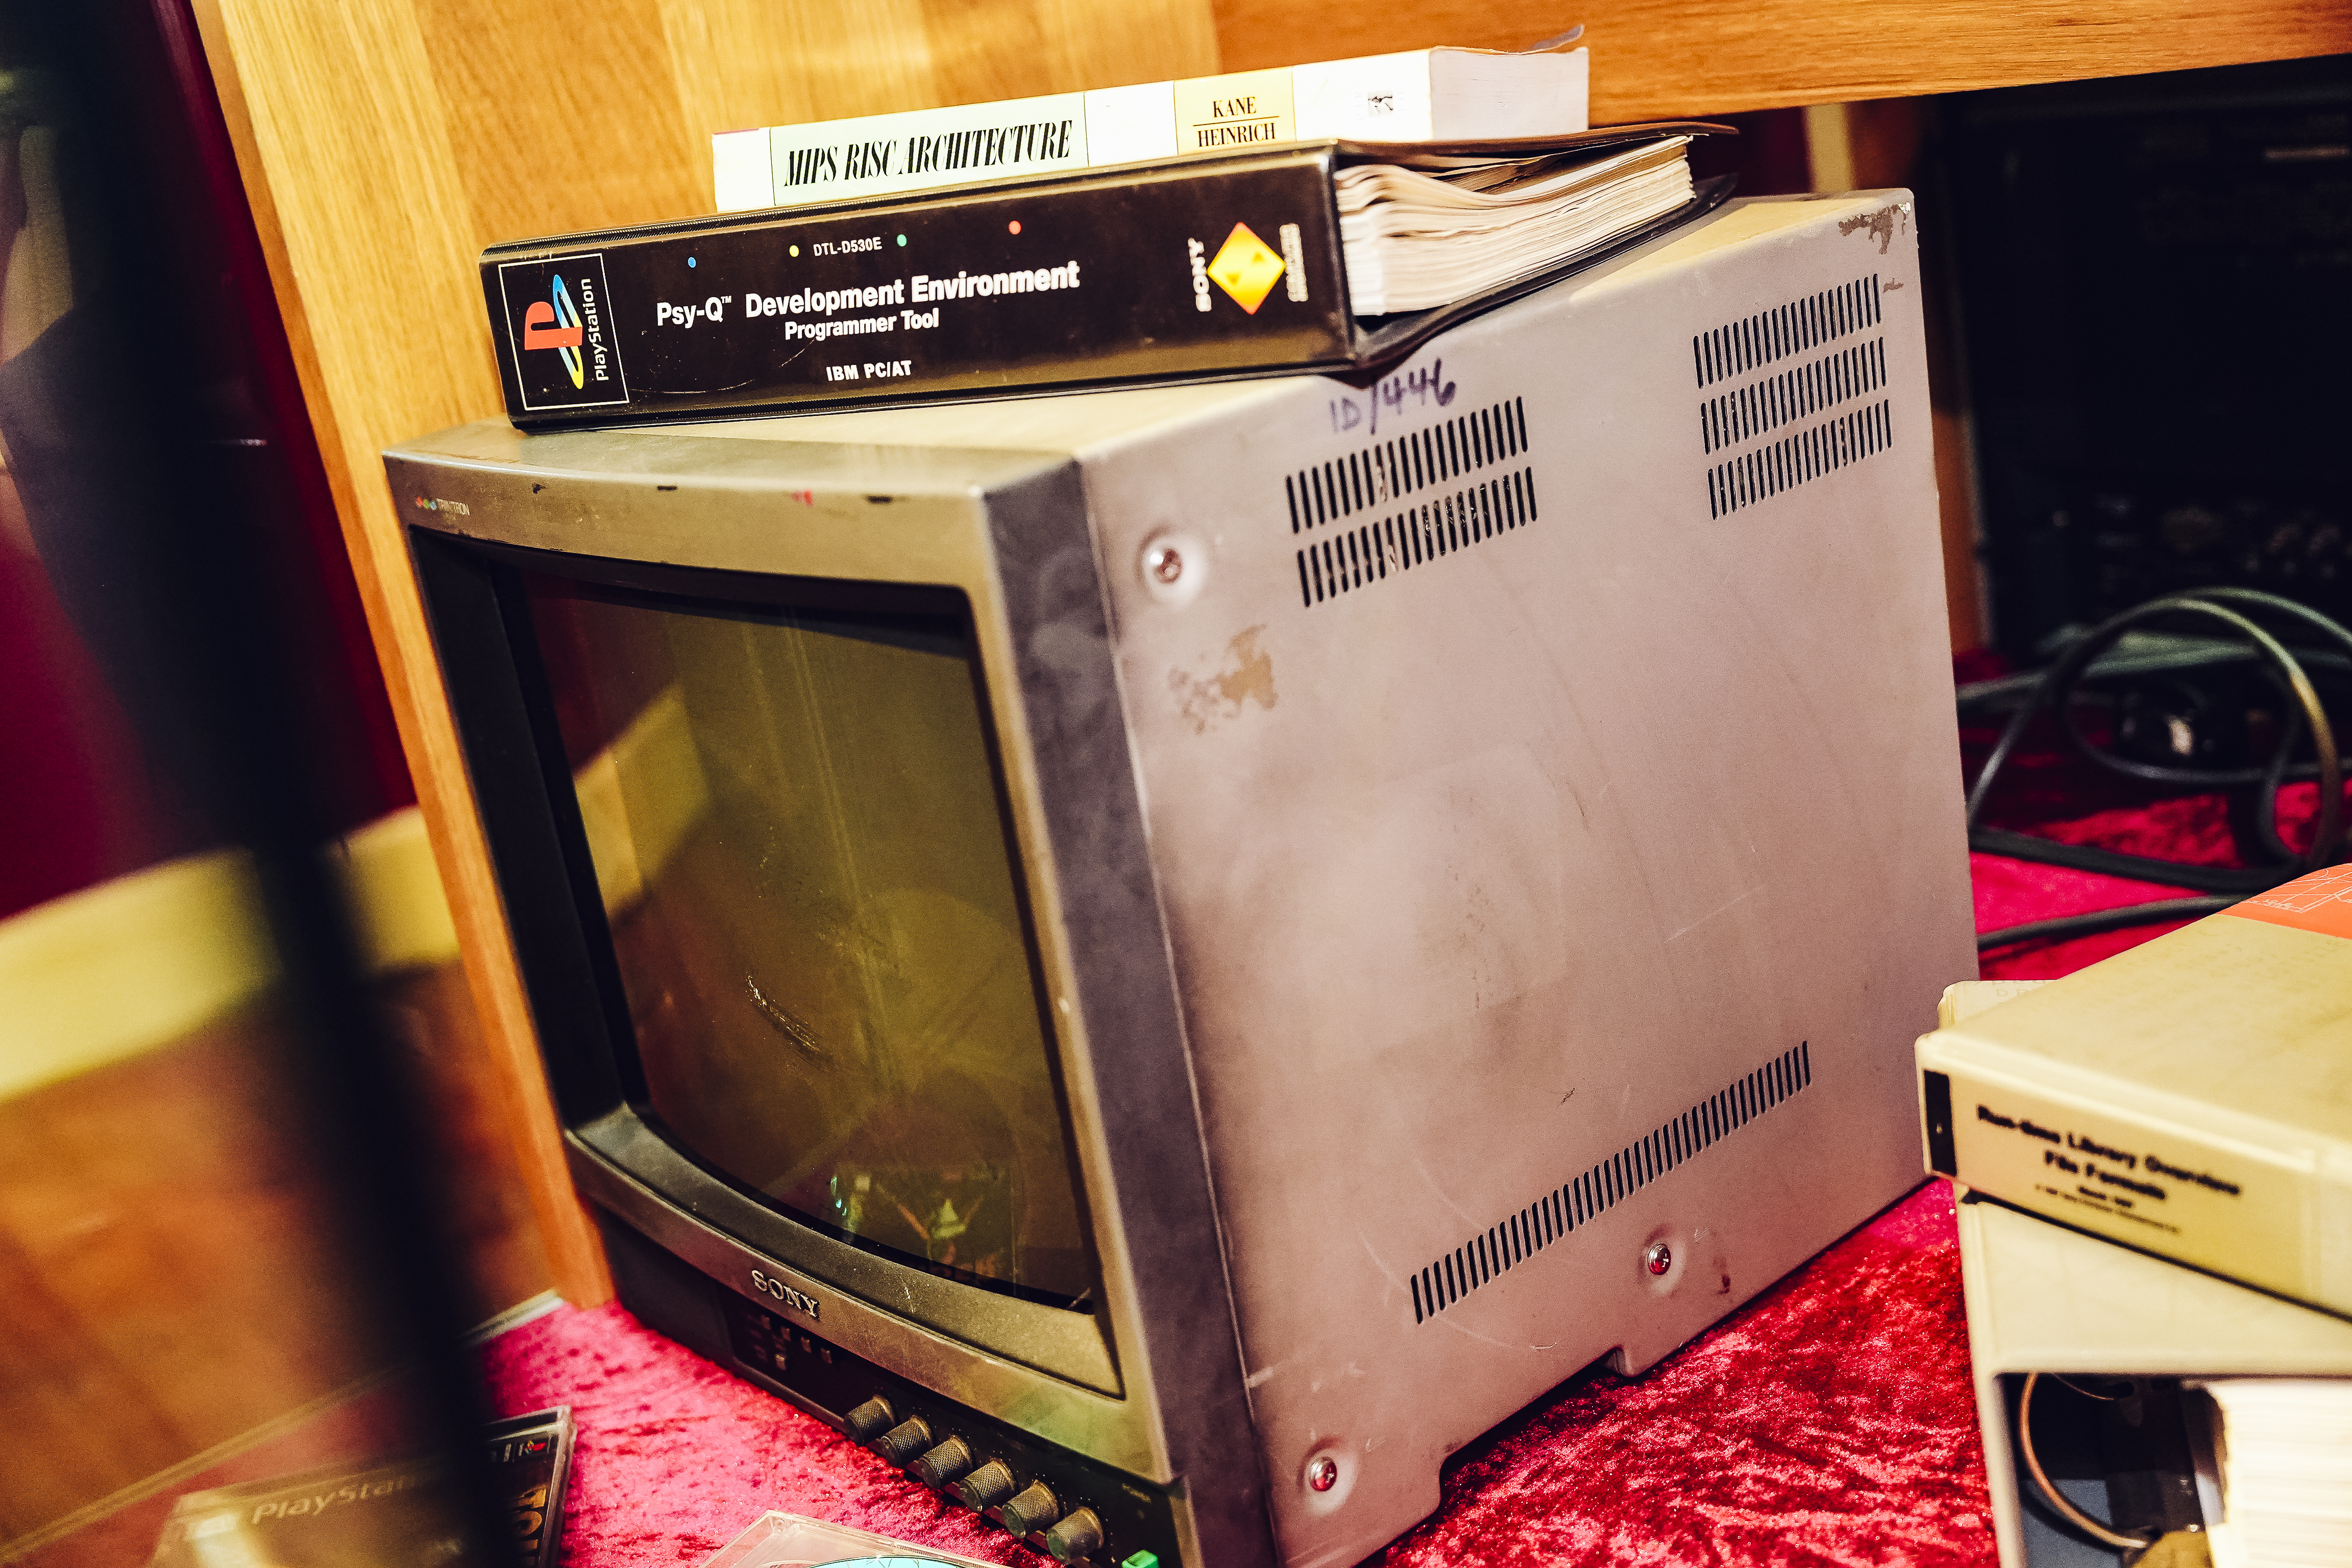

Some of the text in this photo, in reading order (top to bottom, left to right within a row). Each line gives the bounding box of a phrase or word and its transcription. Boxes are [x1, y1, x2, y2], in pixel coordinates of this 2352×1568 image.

[1212, 96, 1256, 118] KANE
[1197, 122, 1276, 147] HEINRICH
[783, 120, 1072, 186] MIPS RISC ARCHITECTURE
[813, 237, 883, 256] DTL-D530E
[746, 279, 904, 317] Development
[911, 260, 1081, 303] Environment
[581, 278, 609, 381] PlayStation
[785, 307, 939, 341] Programmer Tool
[826, 360, 912, 381] IBM PC/AT
[752, 1270, 818, 1317] SONY
